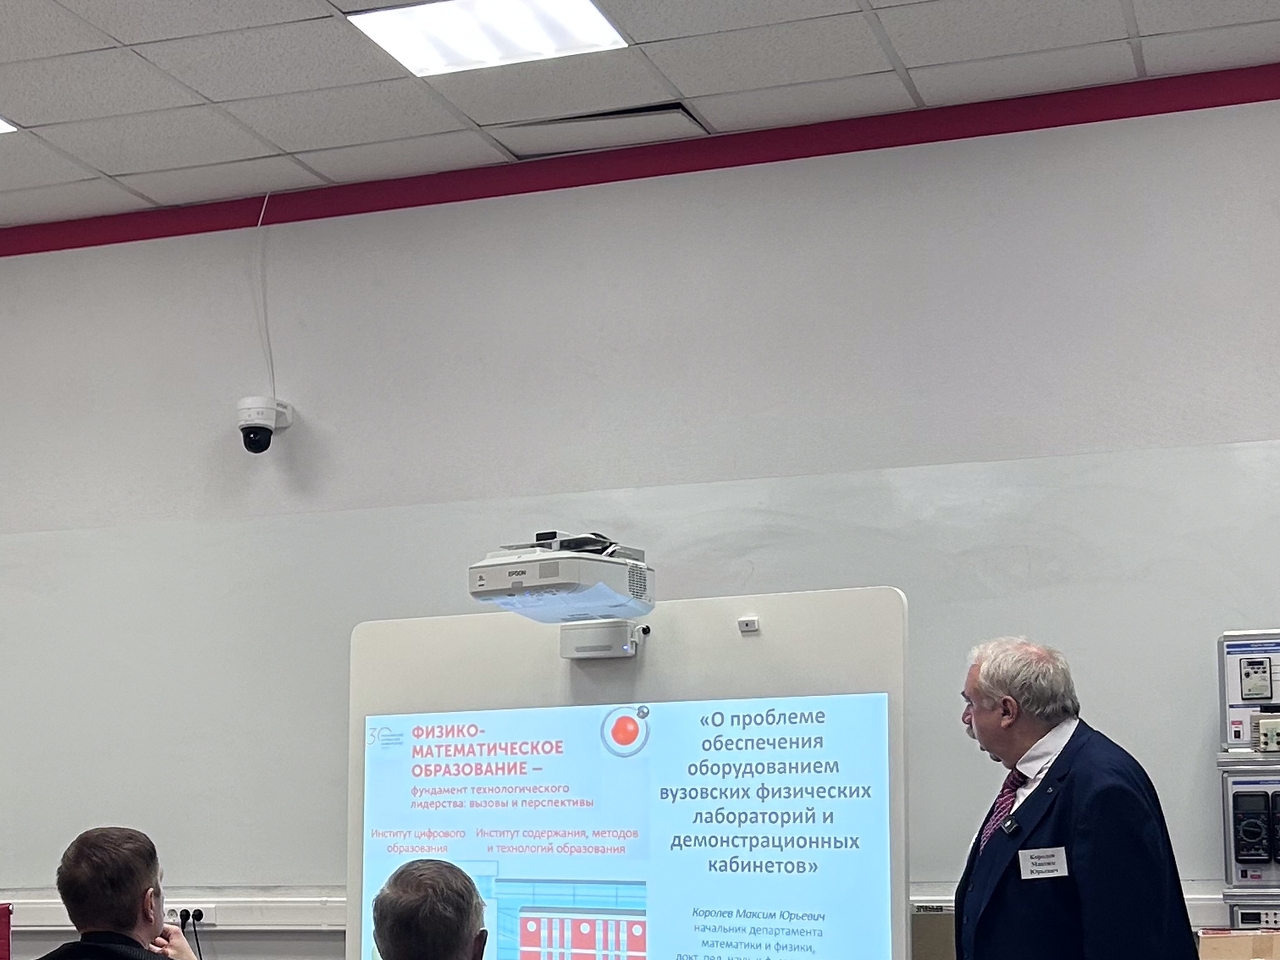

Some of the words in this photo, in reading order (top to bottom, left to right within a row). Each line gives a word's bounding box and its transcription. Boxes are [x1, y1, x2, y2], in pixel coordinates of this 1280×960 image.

[730, 708, 826, 730] проблеме
[411, 723, 486, 740] ФИЗИКО-
[411, 740, 564, 759] МАТЕМАТИЧЕСКОЕ
[701, 734, 824, 752] обеспечения
[411, 761, 528, 778] ОБРАЗОВАНИЕ
[687, 758, 840, 779] оборудованием
[410, 785, 468, 798] фундамент
[470, 783, 570, 796] технологического
[659, 786, 751, 804] вузовских
[756, 782, 872, 803] физических
[410, 799, 466, 810] лидерства:
[469, 799, 509, 808] вызовы
[511, 799, 518, 808] и
[521, 798, 594, 810] перспективы
[692, 807, 816, 828] лабораторий
[822, 811, 834, 824] и
[371, 828, 412, 841] Институт
[414, 828, 466, 841] цифрового
[476, 828, 519, 841] Институт
[522, 829, 589, 840] содержания,
[592, 829, 639, 840] методов
[670, 834, 860, 852] демонстрационных
[387, 843, 448, 855] образования
[487, 844, 493, 853] и
[496, 842, 554, 854] технологий
[556, 843, 626, 856] образования
[708, 855, 818, 874] кабинетов»
[692, 907, 733, 919] Королев
[735, 909, 776, 920] Максим
[779, 910, 825, 922] Юрьевич
[694, 924, 746, 934] начальник
[749, 926, 823, 937] департамента
[701, 940, 761, 950] математики
[764, 942, 771, 950] и
[774, 941, 815, 954] физики,
